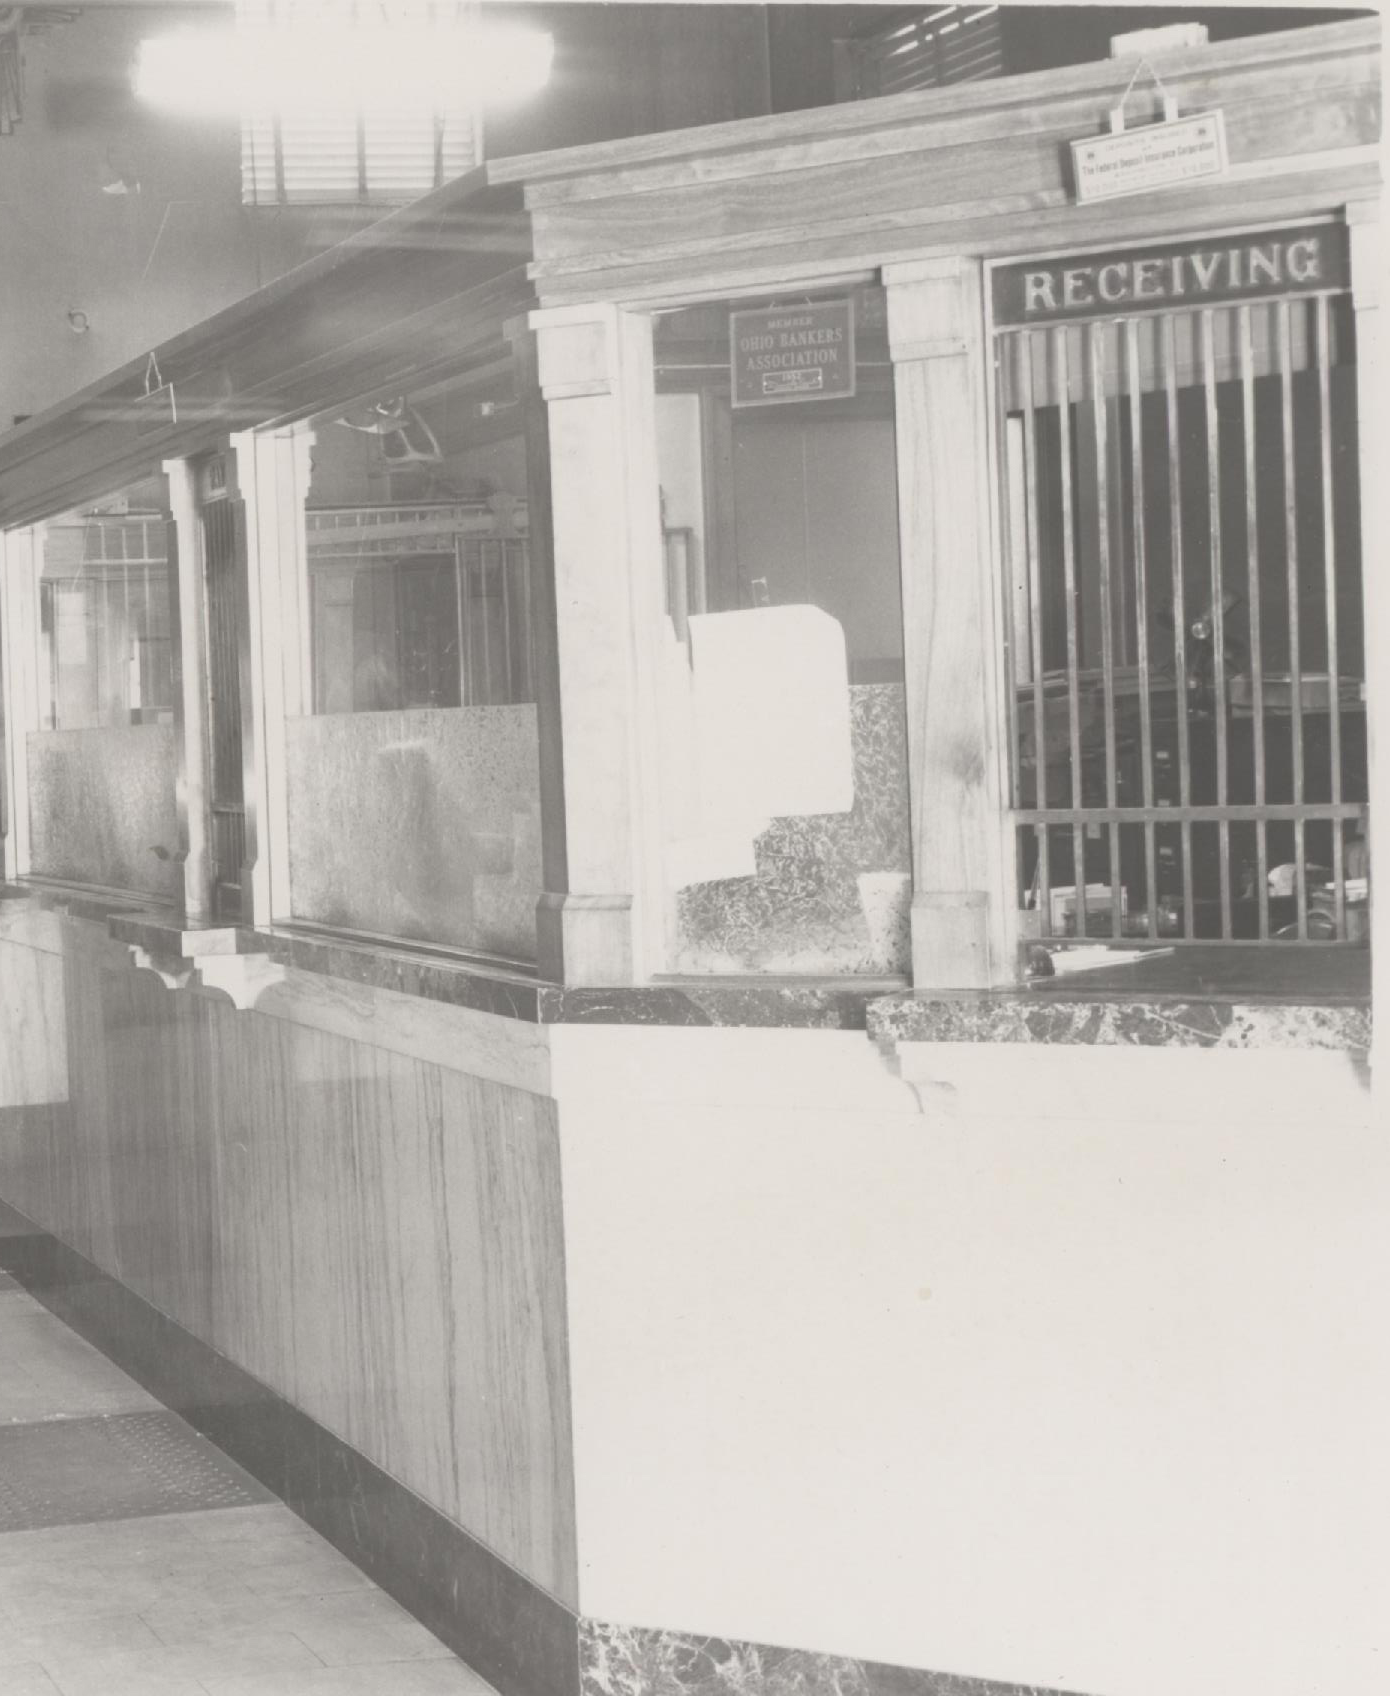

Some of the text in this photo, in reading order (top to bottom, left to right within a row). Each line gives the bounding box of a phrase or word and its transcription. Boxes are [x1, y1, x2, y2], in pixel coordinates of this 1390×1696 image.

[1082, 165, 1094, 176] The
[1095, 160, 1118, 173] Federal
[1119, 154, 1143, 167] Deposit
[1144, 149, 1176, 162] Insurance
[1177, 141, 1215, 156] Corporation
[1025, 238, 1319, 311] RECEIVING
[767, 316, 813, 329] MEMBER
[740, 327, 843, 352] OHIO BANKERS
[746, 348, 838, 370] ASSOCIATION
